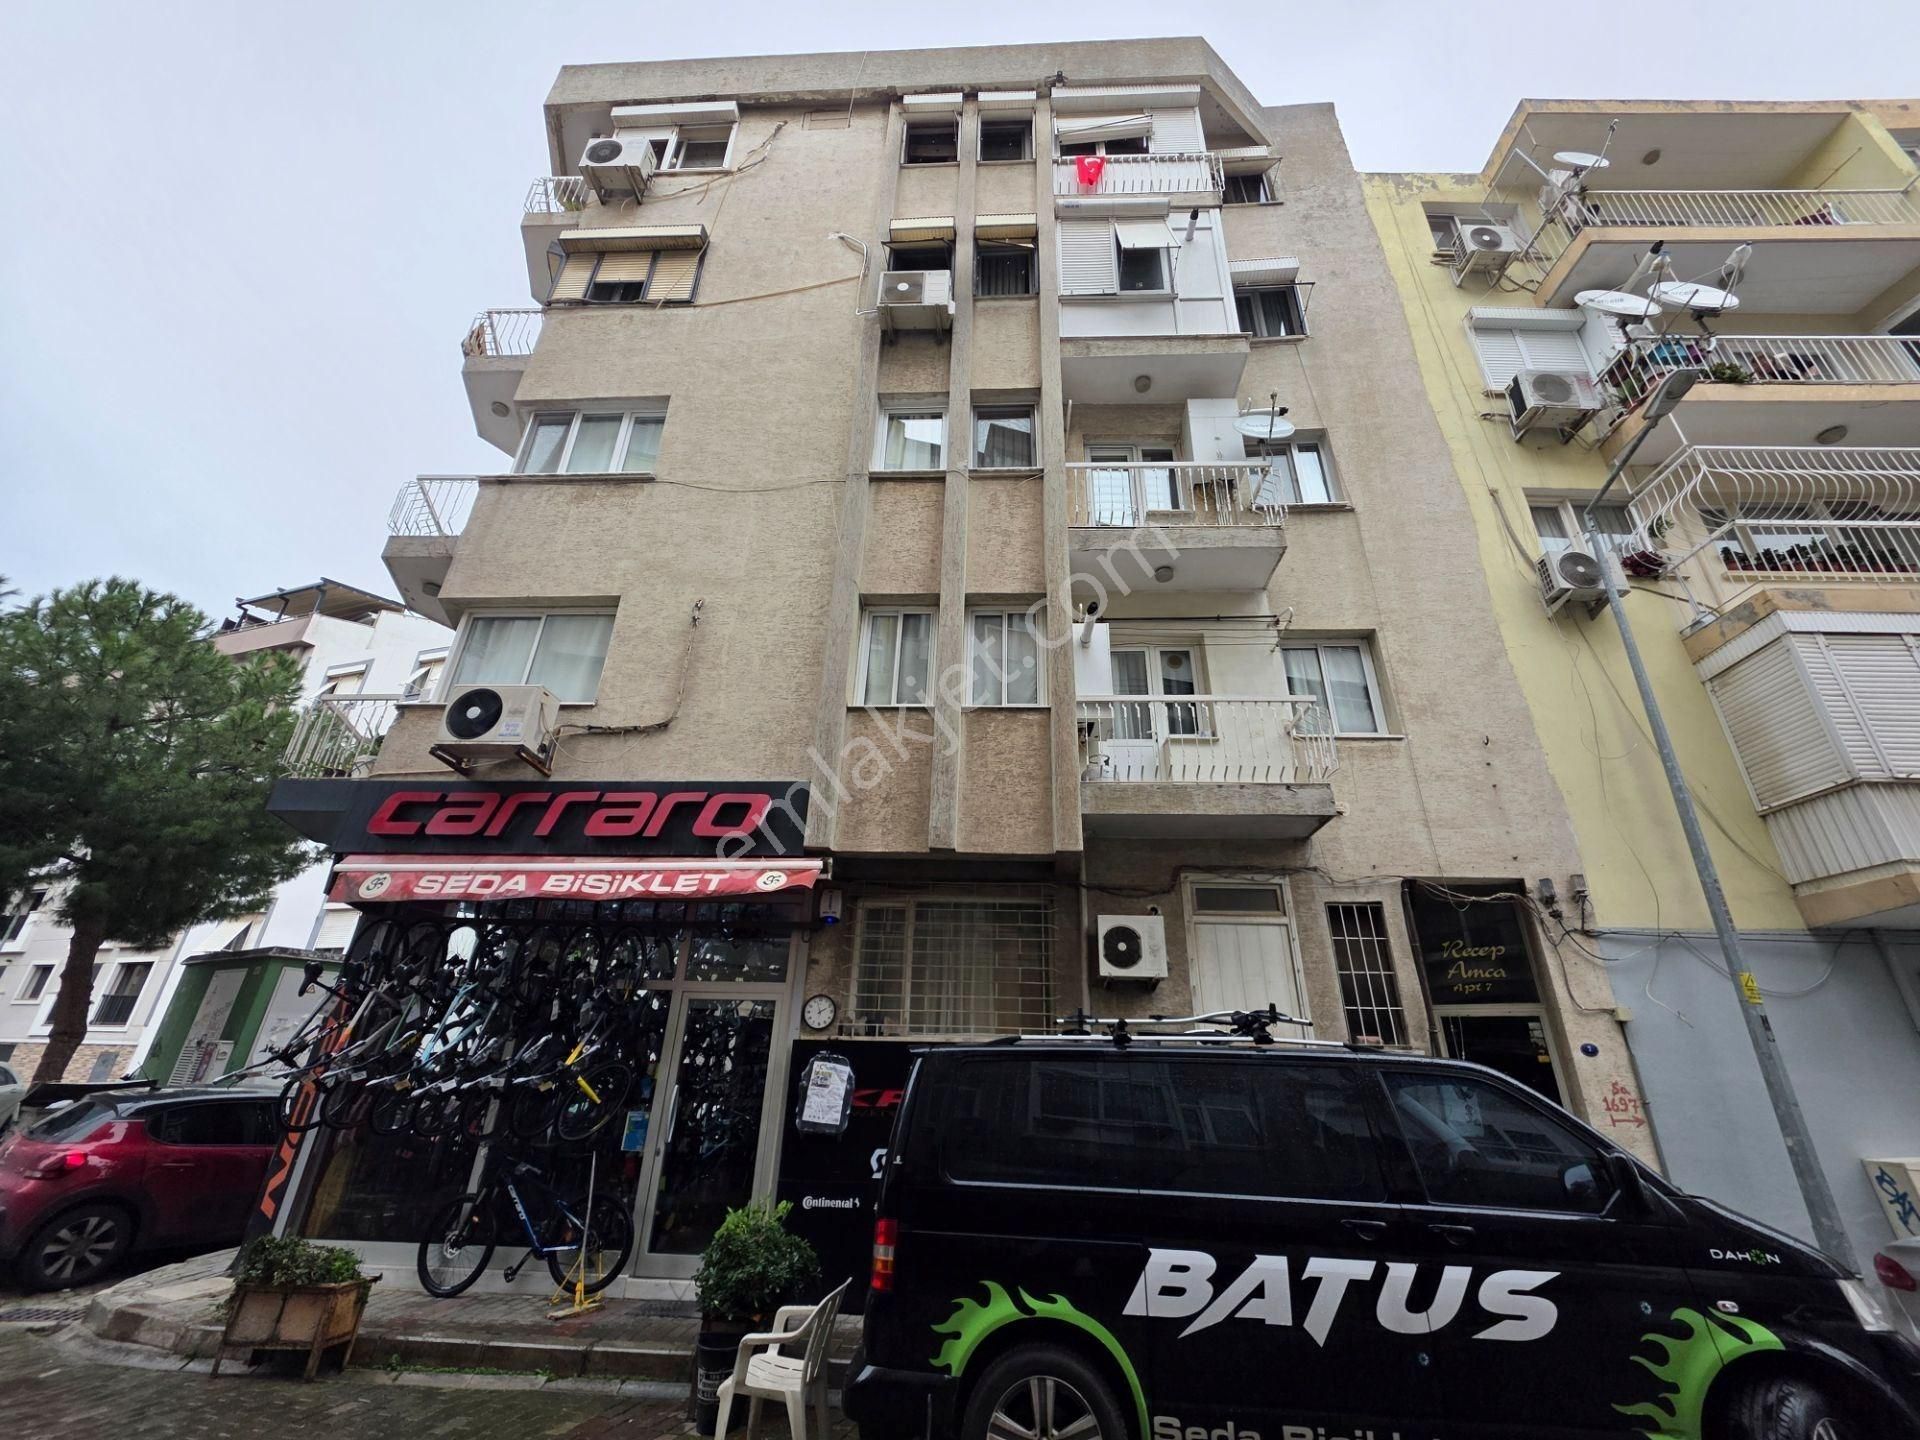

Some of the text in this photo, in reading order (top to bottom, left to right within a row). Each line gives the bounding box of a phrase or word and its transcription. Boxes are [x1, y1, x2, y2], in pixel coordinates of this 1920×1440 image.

[366, 791, 772, 837] carraro
[413, 875, 527, 894] SEDA
[1441, 940, 1506, 961] Recep
[1447, 961, 1506, 979] Amca
[1602, 1096, 1639, 1114] 1697
[802, 1195, 853, 1210] Continental
[1709, 1248, 1781, 1265] DAHON
[1122, 1247, 1562, 1348] BATUS
